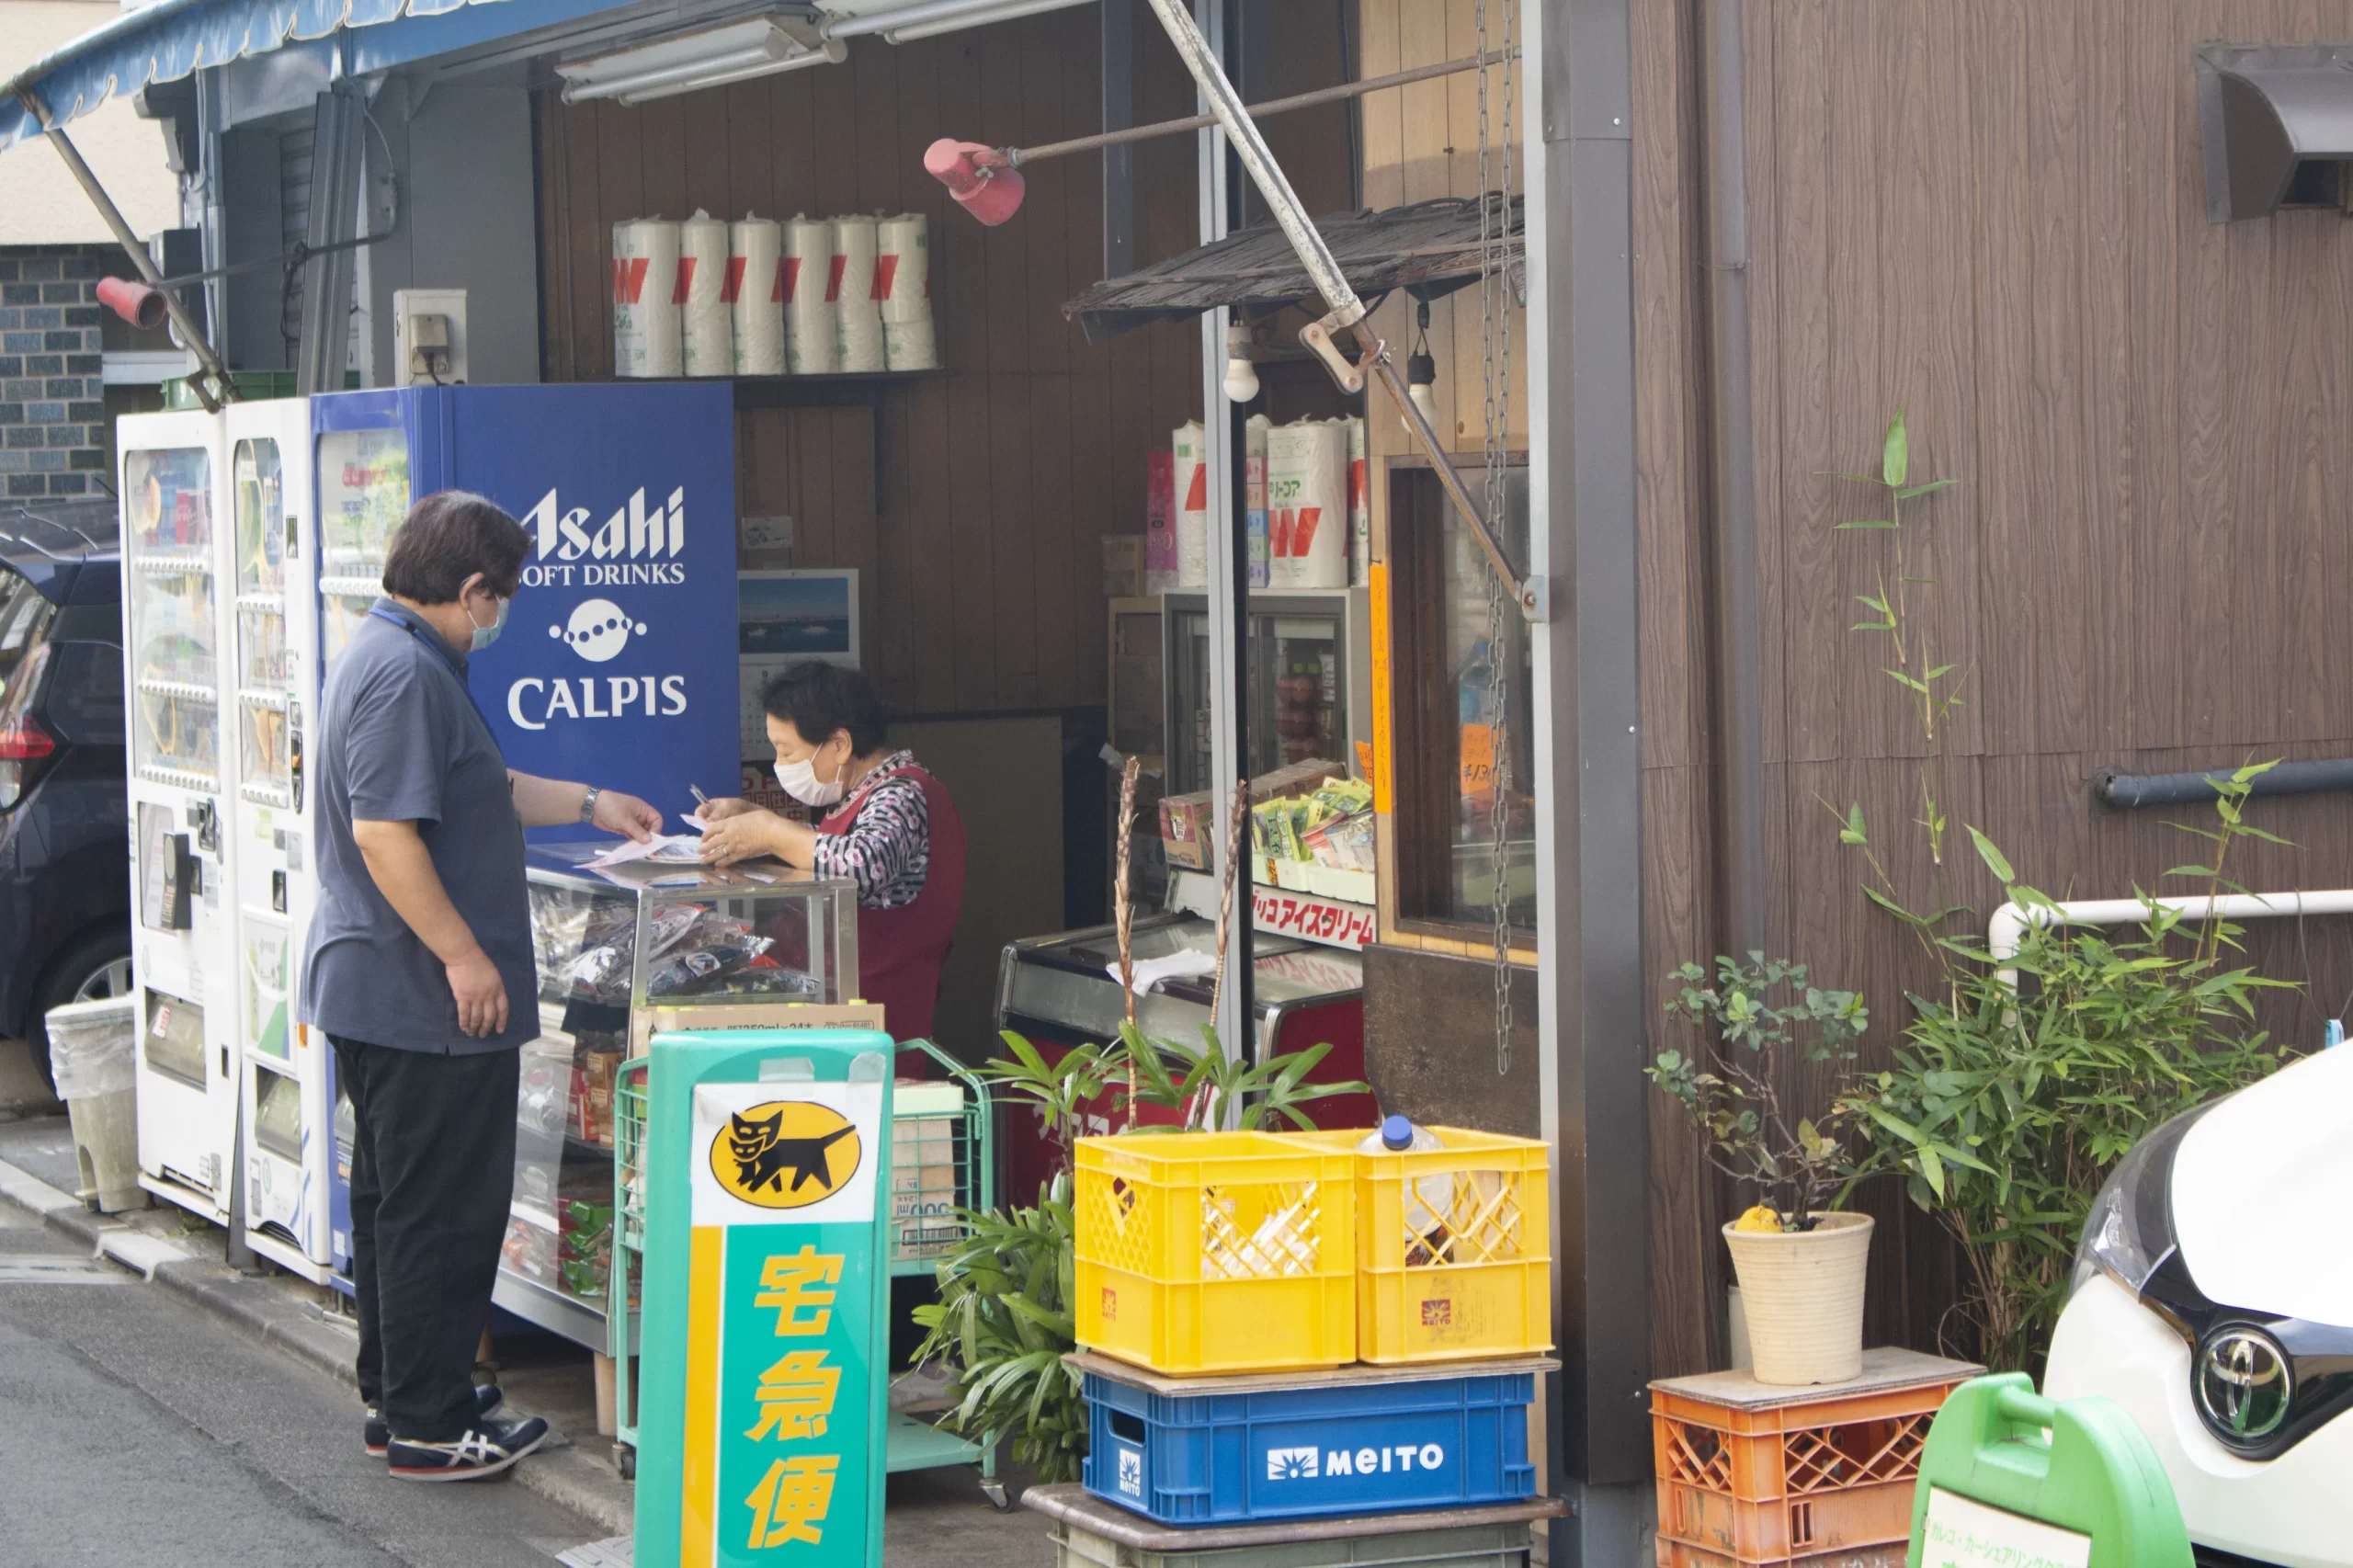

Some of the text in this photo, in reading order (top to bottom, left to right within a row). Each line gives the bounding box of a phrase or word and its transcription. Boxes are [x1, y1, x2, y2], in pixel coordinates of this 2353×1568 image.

[521, 485, 684, 561] Asahi
[518, 562, 685, 587] OFT DRINKS
[507, 676, 688, 730] CALPIS
[745, 1245, 845, 1550] 宅急便
